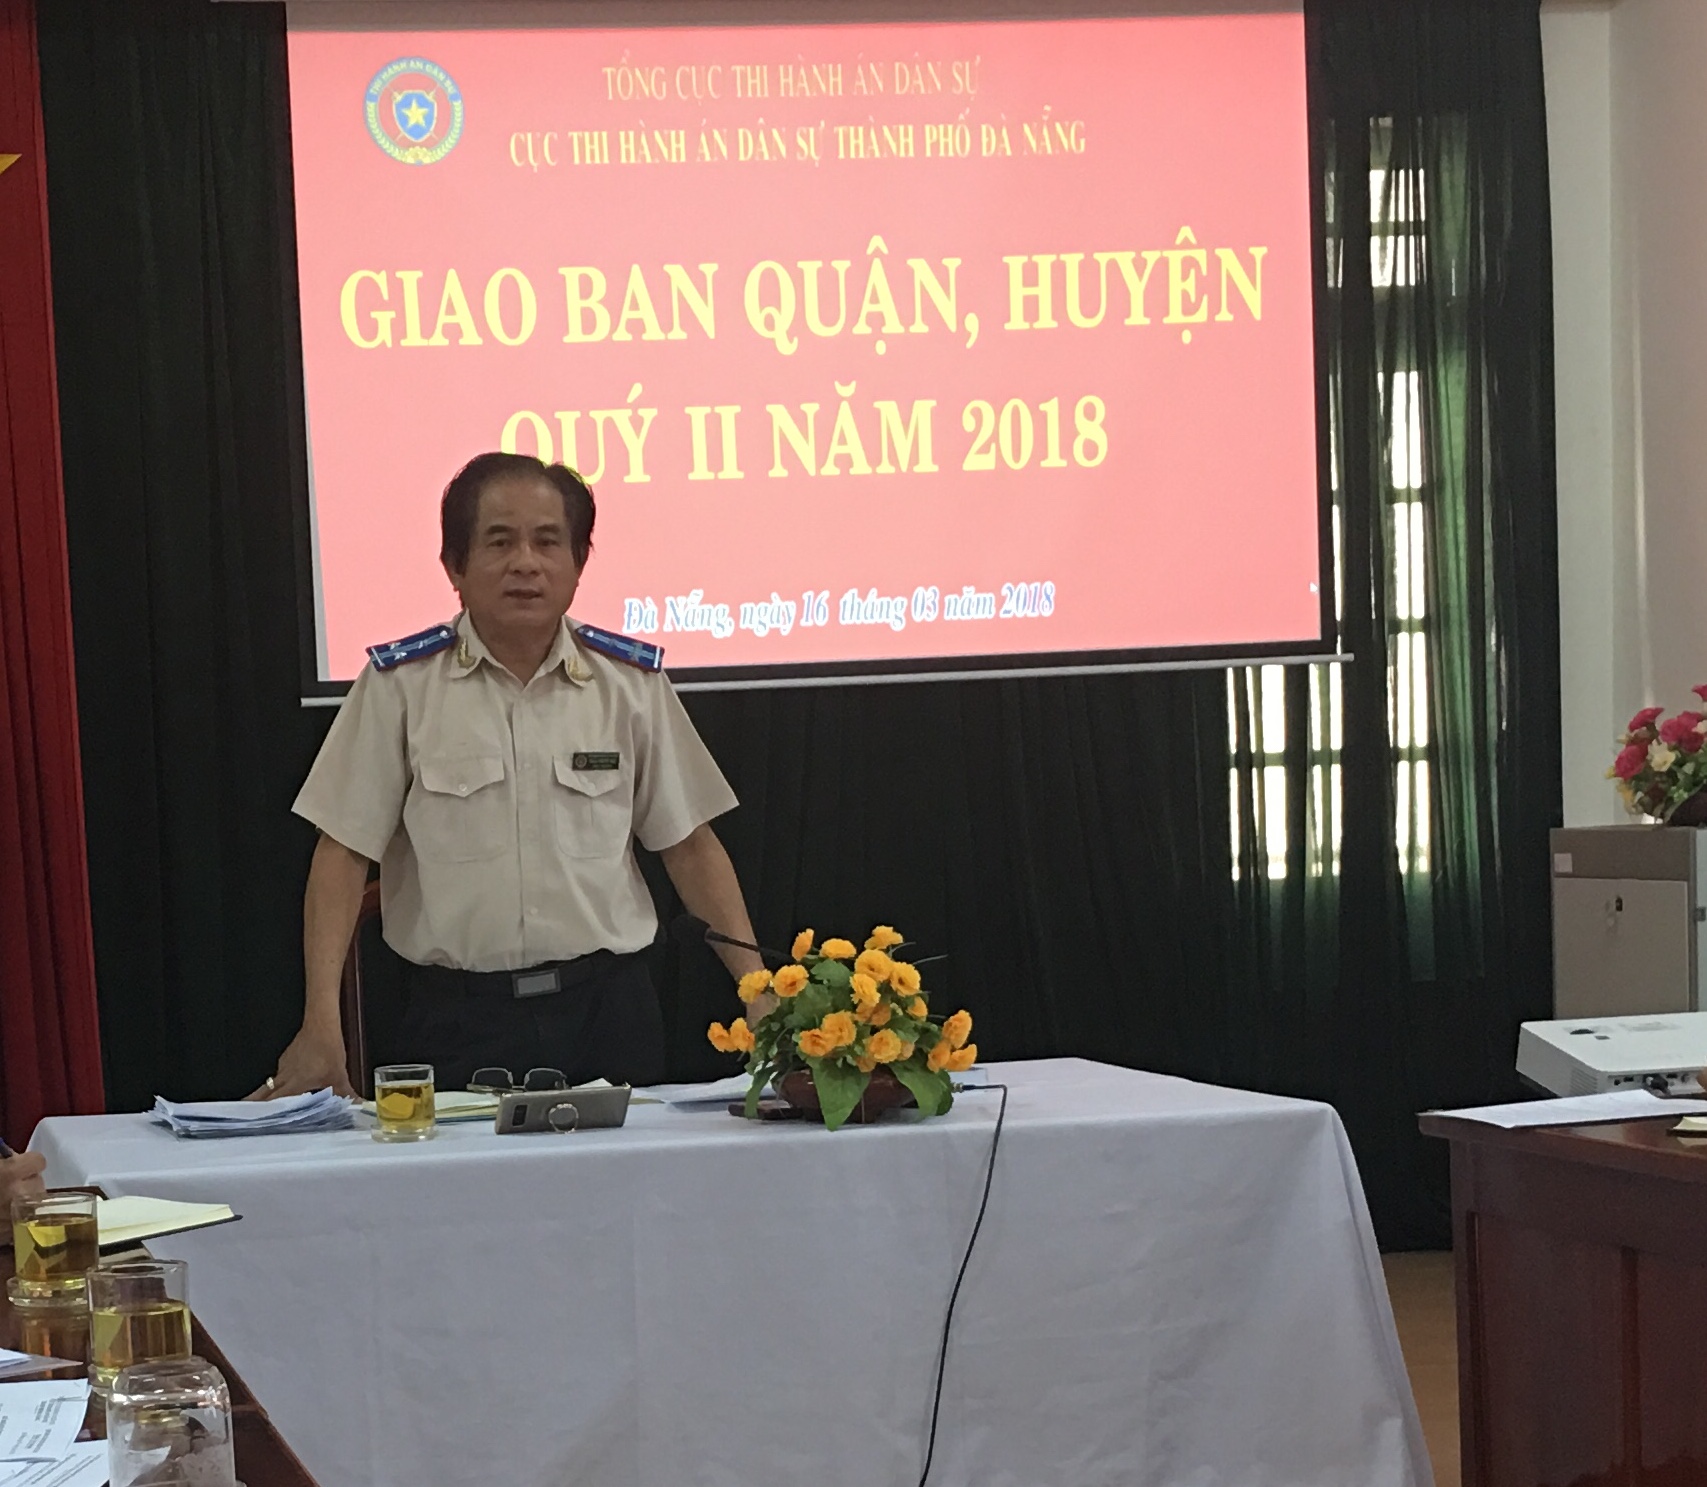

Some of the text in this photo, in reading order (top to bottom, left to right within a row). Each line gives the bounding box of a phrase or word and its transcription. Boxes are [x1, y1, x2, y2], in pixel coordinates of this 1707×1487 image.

[602, 49, 981, 106] TỔNG CỤC THI HÀNH ÁN DÂN SỰ
[509, 131, 558, 172] CỤC
[568, 131, 610, 165] THI
[618, 119, 687, 164] HÀNH
[696, 118, 728, 161] ÁN
[738, 117, 787, 161] DÂN
[796, 120, 826, 167] SỰ
[833, 115, 915, 159] THÀNH
[924, 107, 971, 158] PHỐ
[980, 113, 1012, 157] ĐÀ
[340, 225, 1269, 356] GIAO BAN QUẬN, HUYỆN
[684, 405, 745, 481] II
[765, 380, 940, 478] NĂM
[962, 395, 1109, 471] 2018
[622, 596, 658, 634] Đà
[740, 591, 796, 637] ngày
[800, 590, 830, 627] 16
[839, 587, 908, 632] tháng
[911, 585, 940, 622] 03
[943, 585, 996, 621] năm
[999, 580, 1056, 618] 2018
